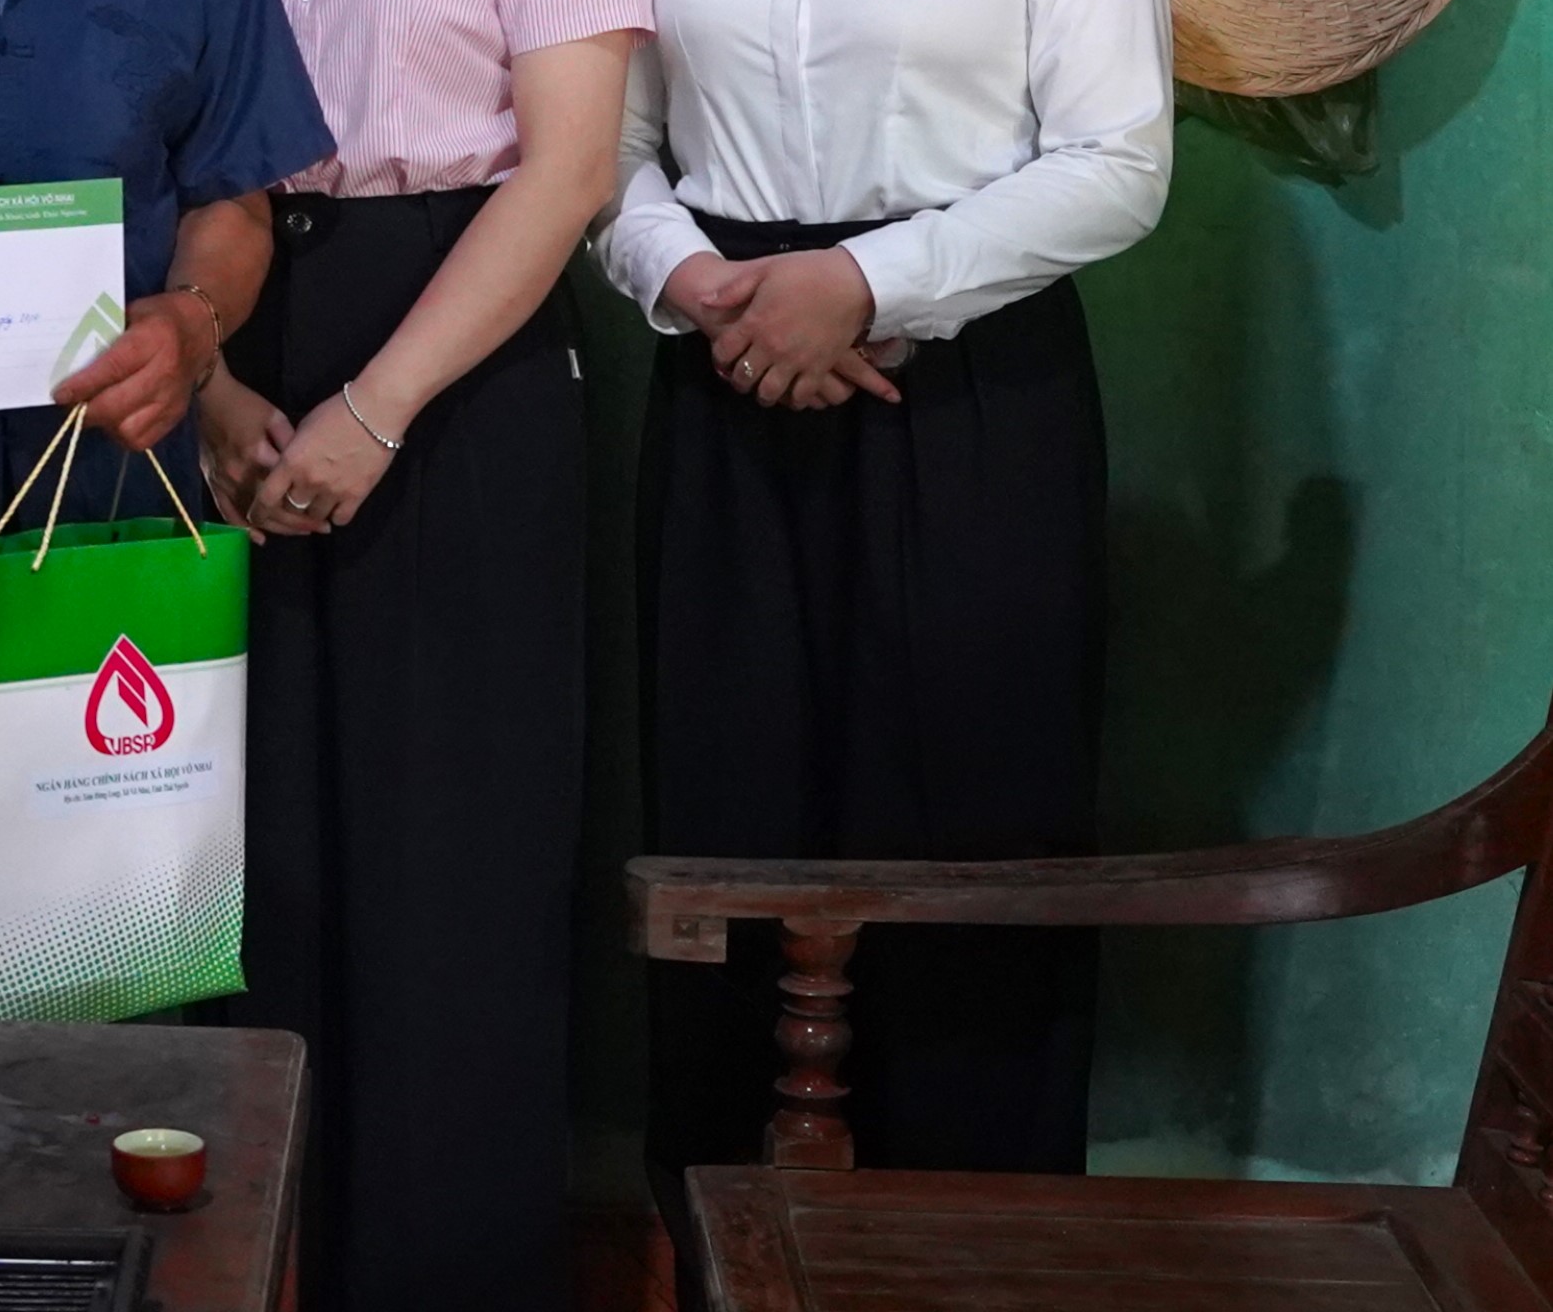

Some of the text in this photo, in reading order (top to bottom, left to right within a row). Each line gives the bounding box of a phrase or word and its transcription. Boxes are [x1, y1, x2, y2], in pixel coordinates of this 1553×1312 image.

[92, 772, 121, 786] CHÍNH
[123, 770, 148, 783] SÁCH
[150, 767, 162, 779] XÃ
